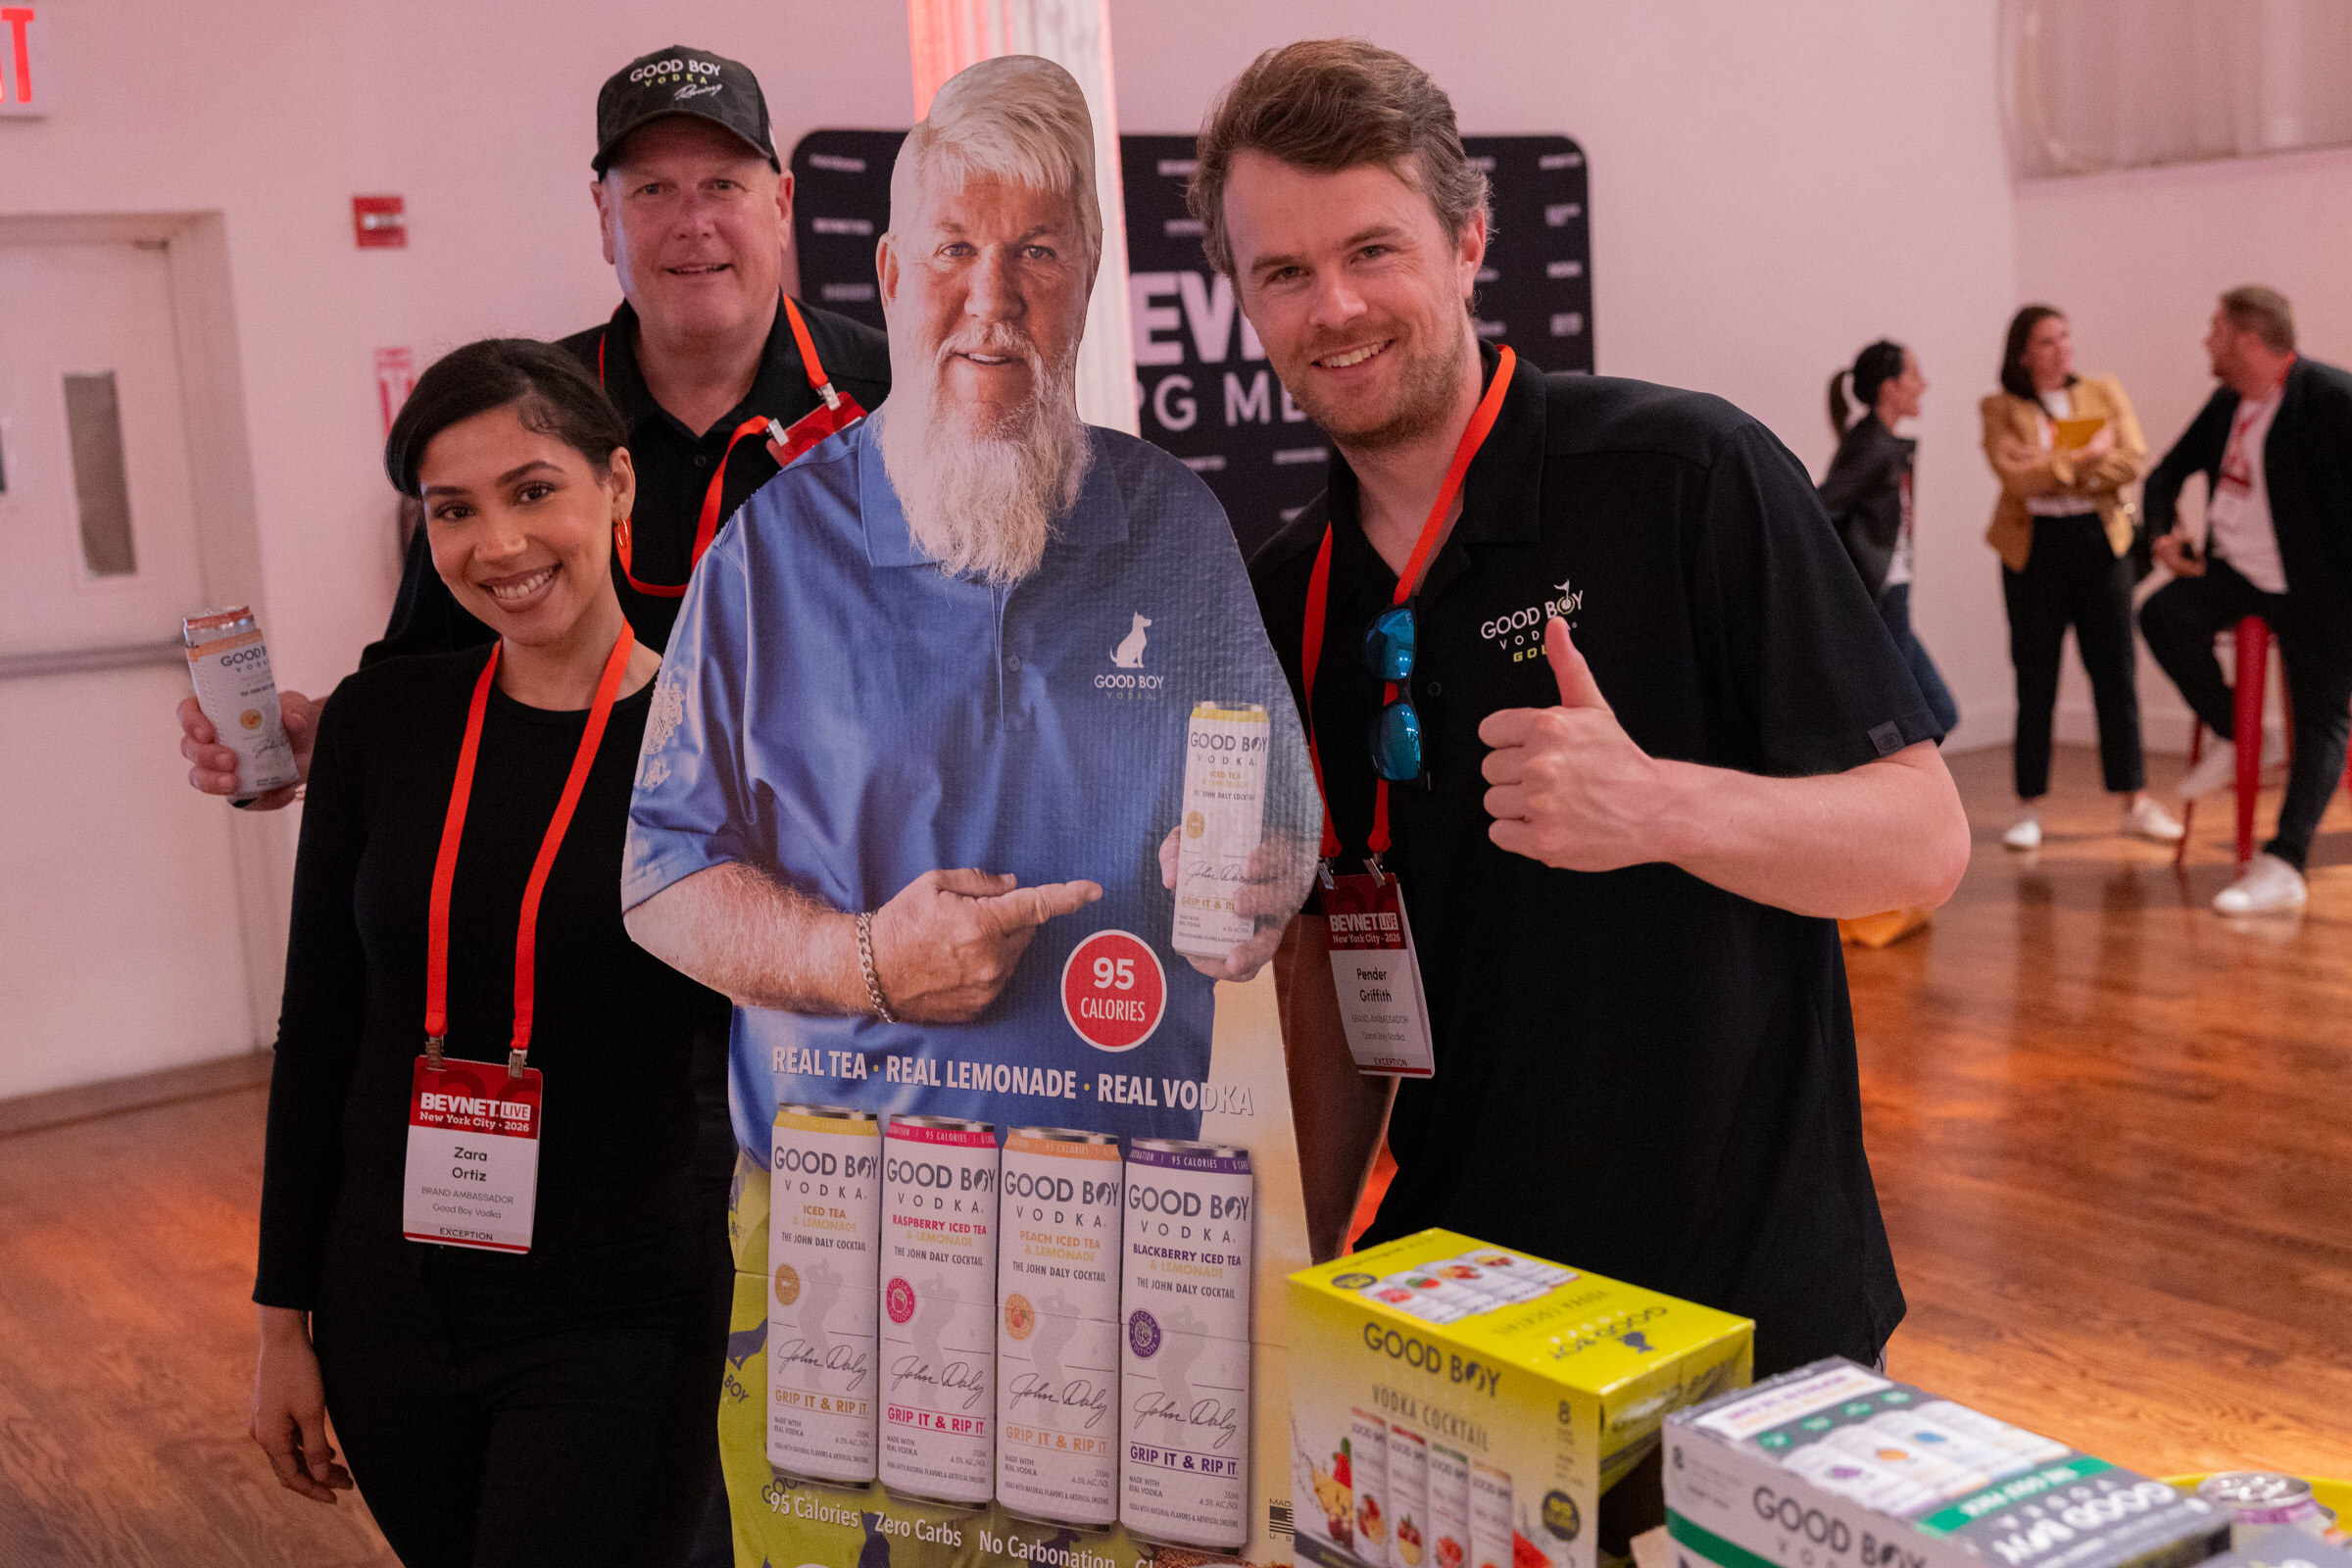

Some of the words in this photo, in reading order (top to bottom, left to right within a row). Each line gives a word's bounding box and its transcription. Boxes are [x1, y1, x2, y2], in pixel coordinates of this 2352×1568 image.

[0, 8, 34, 104] T
[630, 59, 683, 82] GOOD
[688, 60, 720, 76] BOY
[645, 74, 707, 87] VODKA
[1481, 607, 1540, 639] GOOD
[1544, 589, 1584, 619] BOY
[220, 648, 261, 666] GOOD
[1513, 645, 1546, 662] GOL
[1094, 674, 1136, 688] GOOD
[1138, 675, 1164, 689] BOY
[1106, 692, 1153, 701] VODKA
[1190, 732, 1236, 752] GOOD
[1242, 736, 1267, 753] BOY
[1198, 754, 1255, 766] VODKA
[1209, 770, 1226, 779] ICED
[1181, 896, 1200, 906] GRIP
[1202, 899, 1211, 907] IT
[1329, 912, 1379, 932] BEVNET
[1380, 913, 1397, 930] LIVE
[1333, 934, 1348, 944] New
[1348, 934, 1365, 944] York
[1366, 934, 1381, 945] City
[1386, 933, 1400, 942] 2026
[1093, 956, 1135, 991] 95
[1356, 967, 1387, 981] Pender
[1359, 989, 1392, 1003] Griffith
[1080, 998, 1146, 1022] CALORIES
[1370, 1014, 1408, 1024] AMBASSADOR
[1373, 1057, 1407, 1067] EXCEPTION
[772, 1046, 825, 1077] REAL
[828, 1050, 868, 1080] TEA
[886, 1054, 941, 1087] REAL
[947, 1059, 1077, 1100] LEMONADE
[1098, 1073, 1157, 1106] REAL
[1162, 1078, 1254, 1116] VODKA
[420, 1092, 500, 1117] BEVNET
[502, 1102, 530, 1120] LIVE
[419, 1111, 444, 1122] New
[447, 1114, 470, 1126] York
[472, 1117, 496, 1130] City
[504, 1121, 529, 1132] 2026
[925, 1131, 934, 1140] 95
[936, 1132, 967, 1143] CALORIES
[454, 1147, 487, 1161] Zara
[774, 1146, 837, 1175] GOOD
[845, 1154, 878, 1179] BOY
[1171, 1155, 1180, 1165] 95
[1184, 1157, 1217, 1169] CALORIES
[452, 1167, 486, 1182] Ortiz
[887, 1157, 953, 1189] GOOD
[960, 1167, 996, 1193] BOY
[421, 1186, 451, 1198] BRAND
[453, 1190, 514, 1204] AMBASSADOR
[785, 1179, 862, 1200] VODKA
[1004, 1170, 1073, 1202] GOOD
[1082, 1180, 1119, 1206] BOY
[432, 1203, 456, 1213] Good
[458, 1205, 472, 1216] Boy
[475, 1208, 502, 1218] Vodka
[804, 1204, 825, 1217] ICED
[828, 1207, 846, 1219] TEA
[898, 1192, 979, 1213] VODKA
[1129, 1184, 1200, 1216] GOOD
[1210, 1195, 1250, 1221] BOY
[802, 1216, 857, 1232] LEMONADE
[893, 1214, 946, 1231] RASPBERRY
[949, 1223, 970, 1234] ICED
[974, 1225, 987, 1235] TEA
[1017, 1205, 1102, 1228] VODKA
[440, 1227, 493, 1241] EXCEPTION
[782, 1232, 792, 1243] THE
[794, 1234, 812, 1246] JOHN
[815, 1237, 834, 1249] DALY
[836, 1240, 866, 1251] COCKTAIL
[916, 1231, 972, 1247] LEMONADE
[1020, 1231, 1052, 1244] PEACH
[1056, 1236, 1080, 1247] ICED
[1084, 1238, 1101, 1250] TEA
[1141, 1220, 1231, 1243] VODKA
[895, 1246, 905, 1256] THE
[906, 1249, 927, 1260] JOHN
[929, 1251, 949, 1263] DALY
[952, 1254, 983, 1266] COCKTAIL
[1036, 1246, 1096, 1262] LEMONADE
[1133, 1243, 1197, 1262] BLACKBERRY
[1200, 1252, 1224, 1264] ICED
[1227, 1255, 1242, 1266] TEA
[1013, 1260, 1023, 1271] THE
[1026, 1263, 1046, 1275] JOHN
[1050, 1266, 1070, 1278] DALY
[1074, 1269, 1105, 1282] COCKTAIL
[1161, 1260, 1224, 1278] LEMONADE
[1137, 1277, 1149, 1288] THE
[1151, 1279, 1172, 1292] JOHN
[1176, 1283, 1198, 1295] DALY
[1200, 1286, 1235, 1299] COCKTAIL
[1131, 1339, 1156, 1356] EDITION
[1364, 1322, 1443, 1374] GOOD
[1450, 1354, 1501, 1397] BOY
[723, 1374, 750, 1403] BOY
[775, 1389, 800, 1404] GRIP
[805, 1395, 815, 1407] IT
[820, 1397, 831, 1410] &
[837, 1399, 856, 1413] RIP
[858, 1403, 867, 1415] IT
[888, 1407, 913, 1423] GRIP
[918, 1412, 930, 1426] IT
[935, 1416, 946, 1429] &
[952, 1418, 971, 1432] RIP
[976, 1421, 984, 1434] IT
[1372, 1384, 1417, 1420] VODKA
[1423, 1403, 1490, 1453] COCKTAIL
[1006, 1426, 1033, 1443] GRIP
[1039, 1432, 1051, 1446] IT
[1055, 1435, 1067, 1449] &
[1074, 1437, 1095, 1451] RIP
[1099, 1441, 1107, 1454] IT
[1130, 1446, 1158, 1462] GRIP
[1164, 1451, 1177, 1466] IT
[1183, 1455, 1195, 1469] &
[1201, 1457, 1223, 1473] RIP
[1228, 1461, 1237, 1475] IT
[770, 1492, 791, 1515] 95
[794, 1496, 858, 1528] Calories
[1269, 1498, 1293, 1507] MAD
[875, 1510, 910, 1538] Zero
[915, 1519, 961, 1547] Carbs
[1753, 1485, 1850, 1553] GOOD
[980, 1530, 1003, 1555] No
[1007, 1535, 1115, 1568] Carbonation
